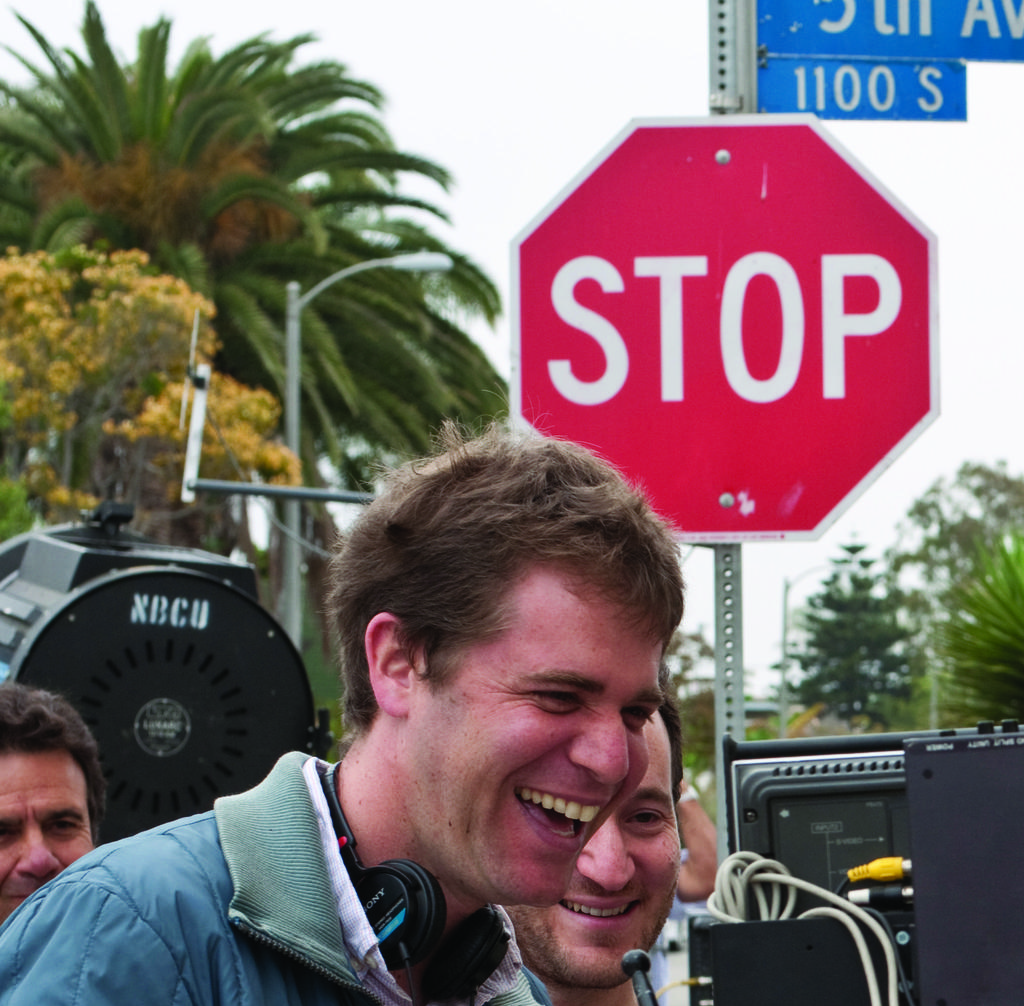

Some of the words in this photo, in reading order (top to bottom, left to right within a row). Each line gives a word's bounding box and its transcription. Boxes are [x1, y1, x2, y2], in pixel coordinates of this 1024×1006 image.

[795, 65, 896, 112] 1100
[918, 66, 943, 112] S
[547, 251, 903, 406] STOP
